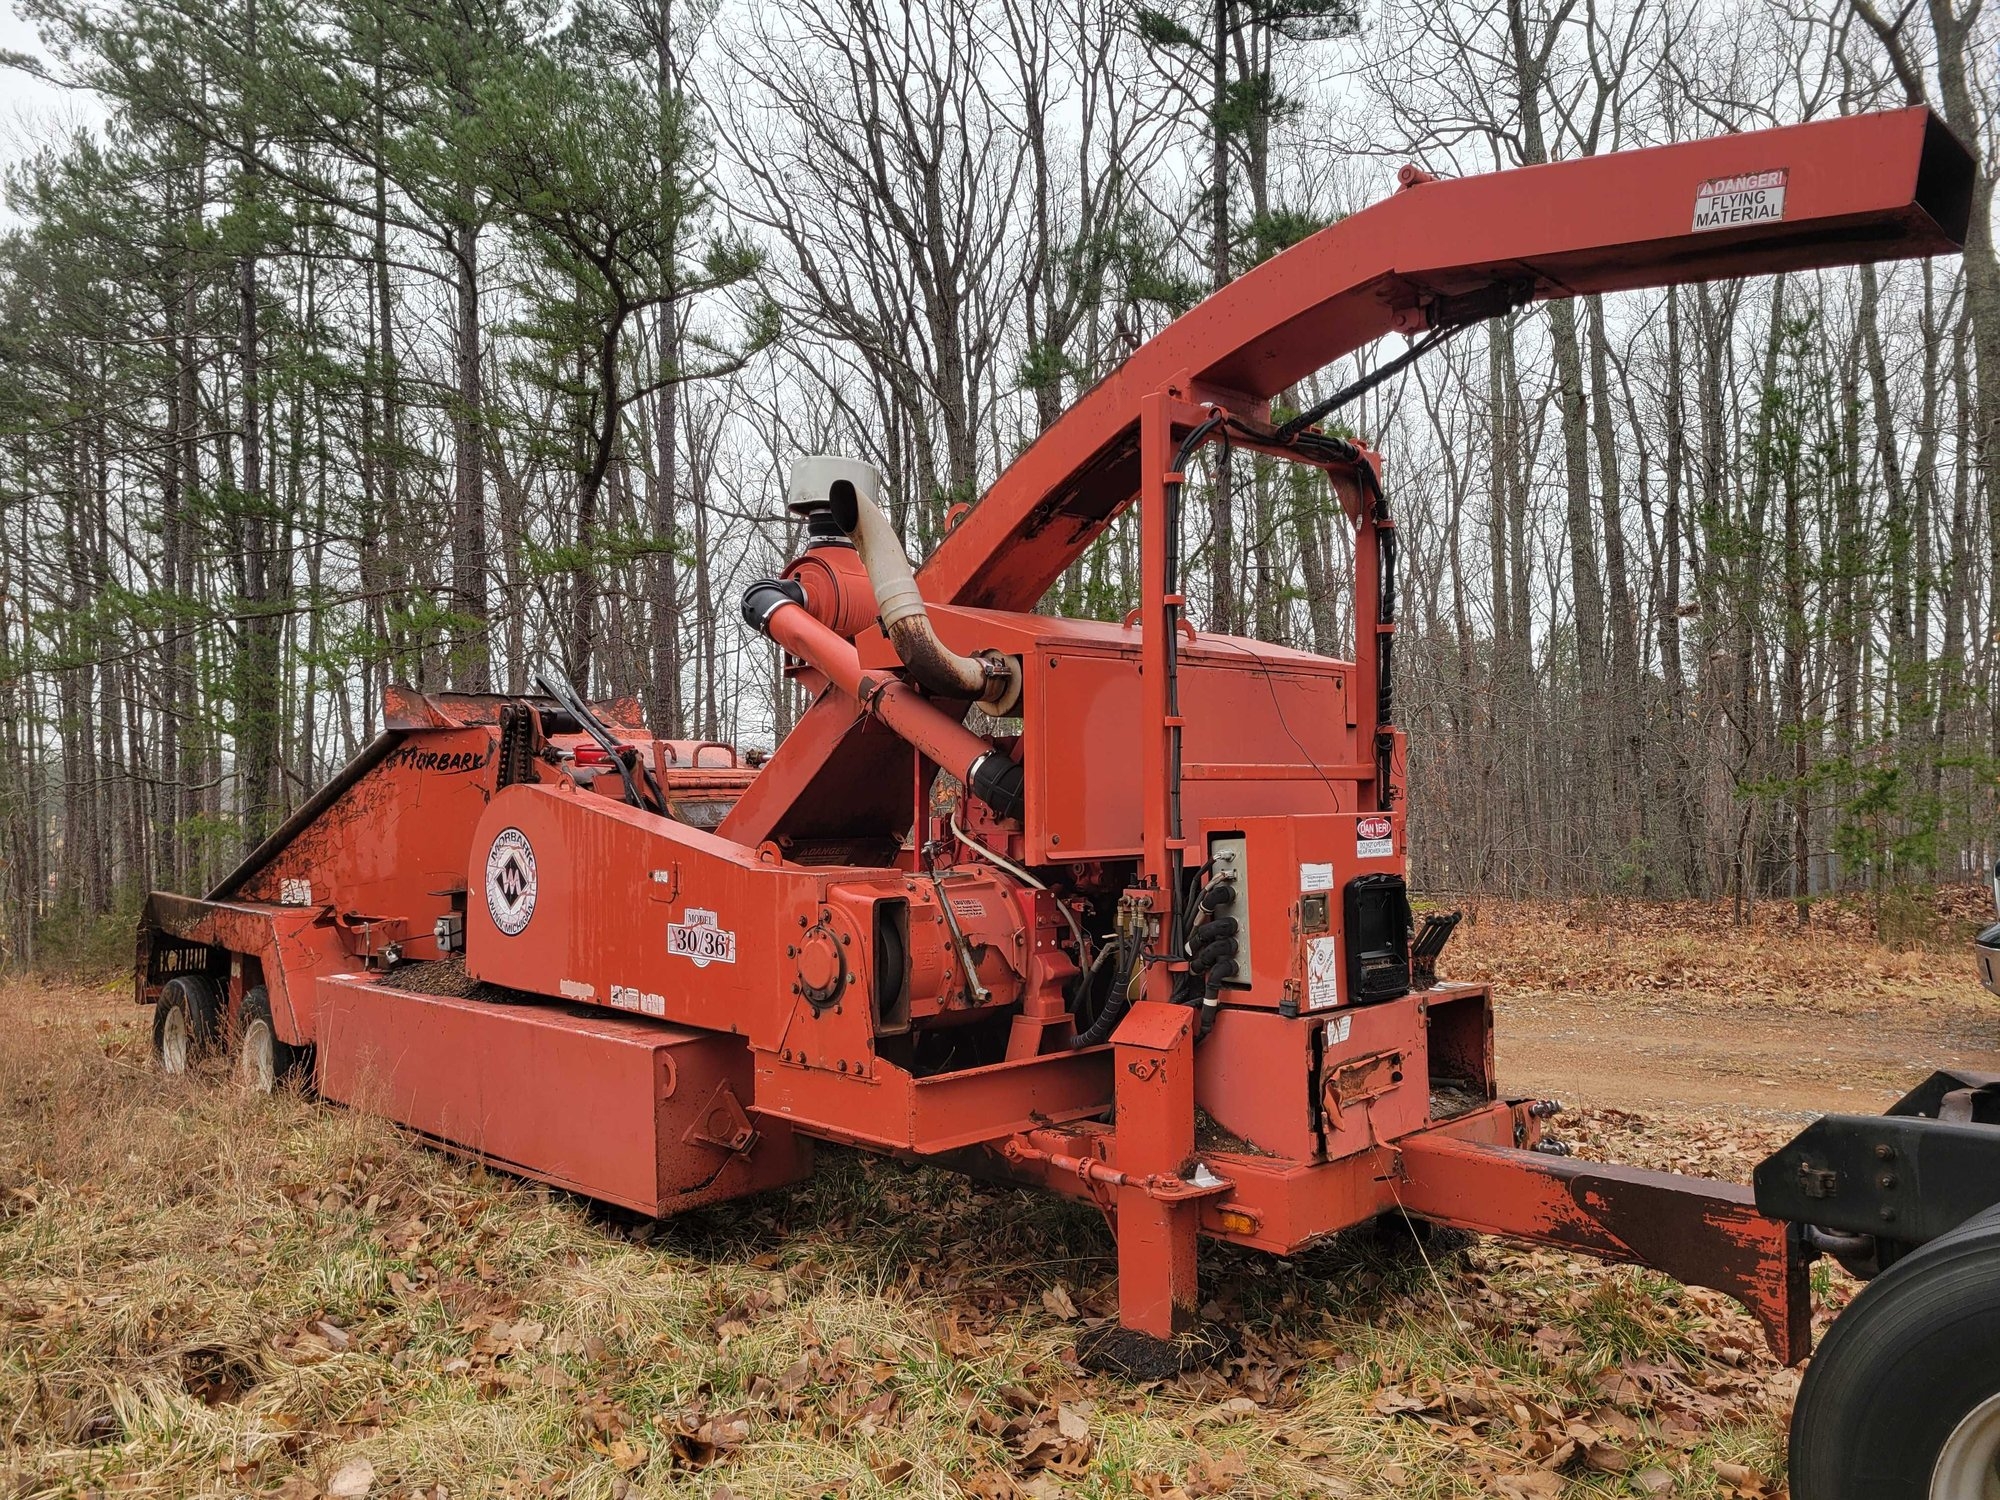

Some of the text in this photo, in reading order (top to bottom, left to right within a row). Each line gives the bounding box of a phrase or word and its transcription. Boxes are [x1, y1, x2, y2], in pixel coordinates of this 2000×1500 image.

[1714, 171, 1783, 195] DANGER!
[1711, 190, 1766, 211] FLYING
[1696, 203, 1780, 228] MATERIAL
[491, 831, 534, 866] MORBARK
[504, 903, 534, 934] MICHIGAN
[687, 913, 714, 926] MODEL
[676, 928, 726, 957] 30/36
